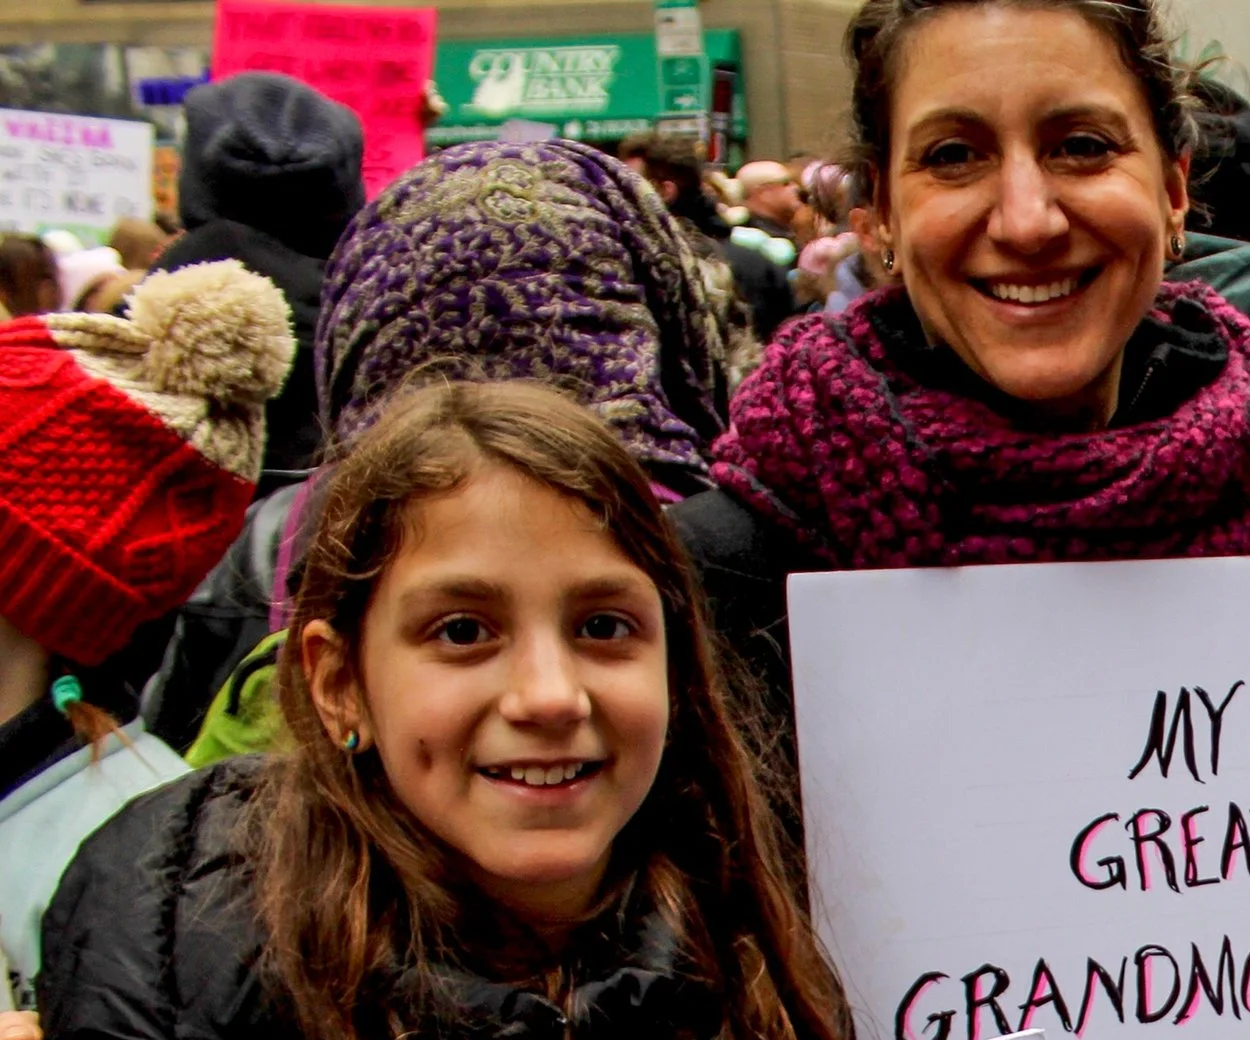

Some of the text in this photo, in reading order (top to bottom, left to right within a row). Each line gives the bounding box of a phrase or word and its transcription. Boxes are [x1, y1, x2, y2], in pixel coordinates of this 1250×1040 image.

[469, 47, 618, 77] COUNTRY
[524, 76, 609, 100] BANK
[1128, 681, 1245, 784] MY
